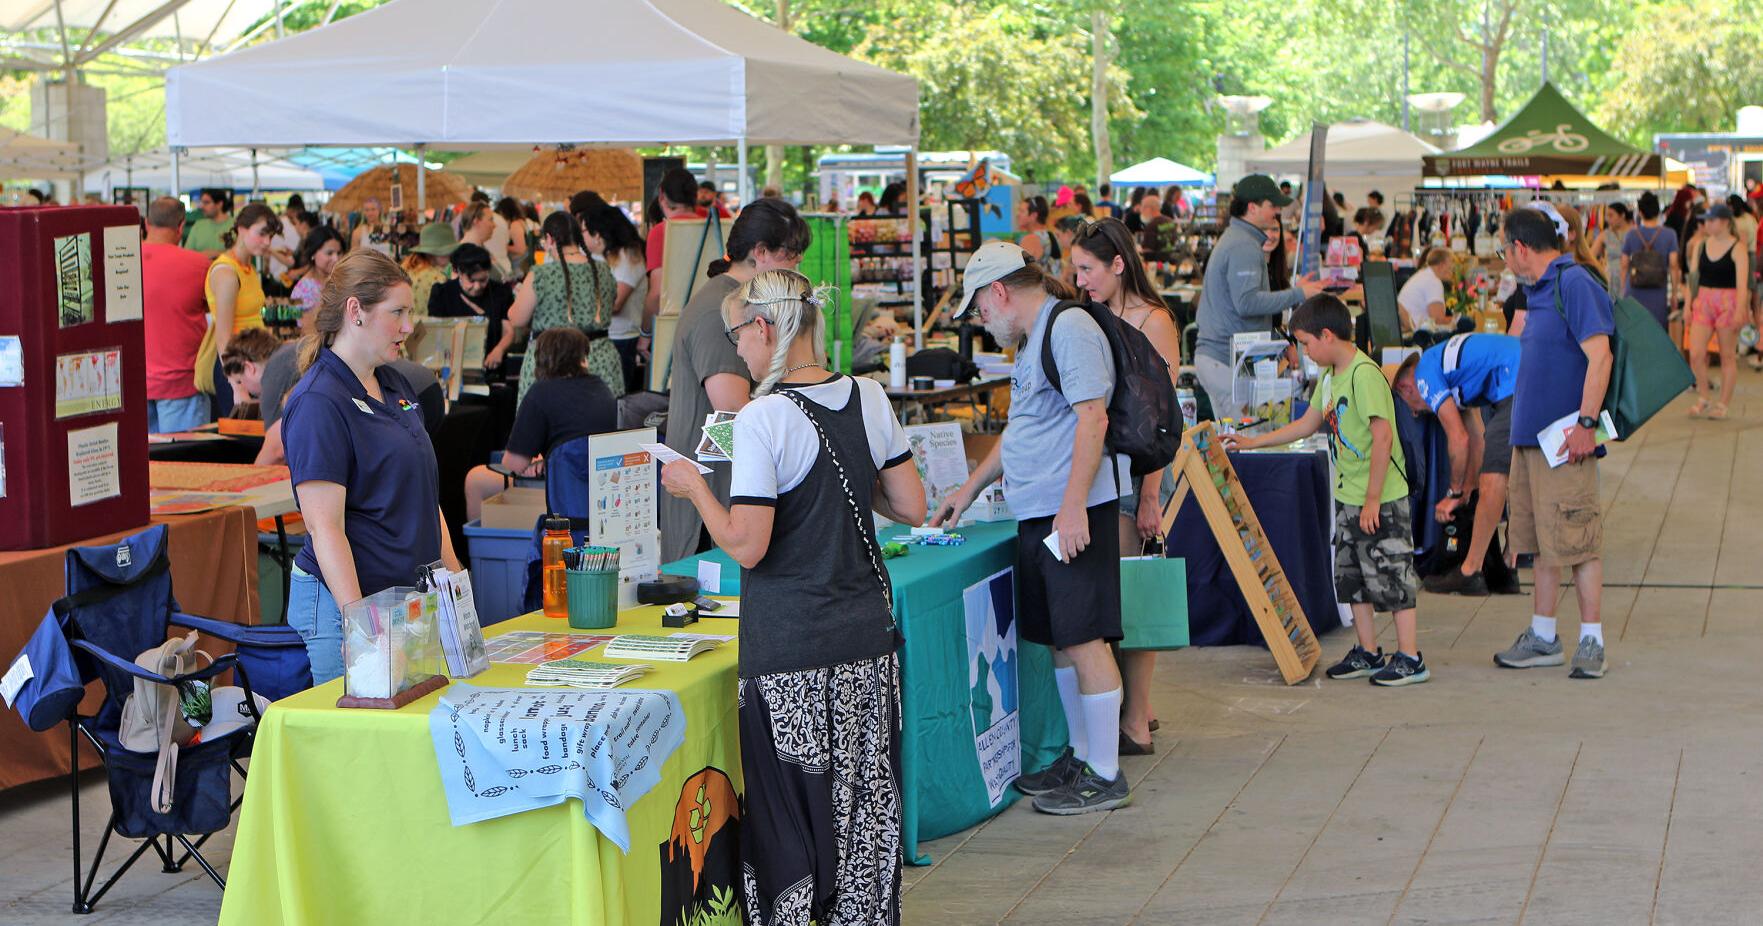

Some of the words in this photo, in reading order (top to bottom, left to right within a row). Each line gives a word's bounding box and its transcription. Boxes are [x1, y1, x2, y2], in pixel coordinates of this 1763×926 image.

[1473, 158, 1499, 169] WAYNE
[929, 440, 957, 449] Species
[930, 430, 954, 439] Native
[510, 728, 519, 752] lunch
[519, 728, 528, 750] sack
[978, 732, 996, 752] ALLEN
[995, 715, 1018, 740] COUNTY
[540, 740, 550, 760] food
[576, 739, 585, 755] gift
[590, 735, 606, 759] place
